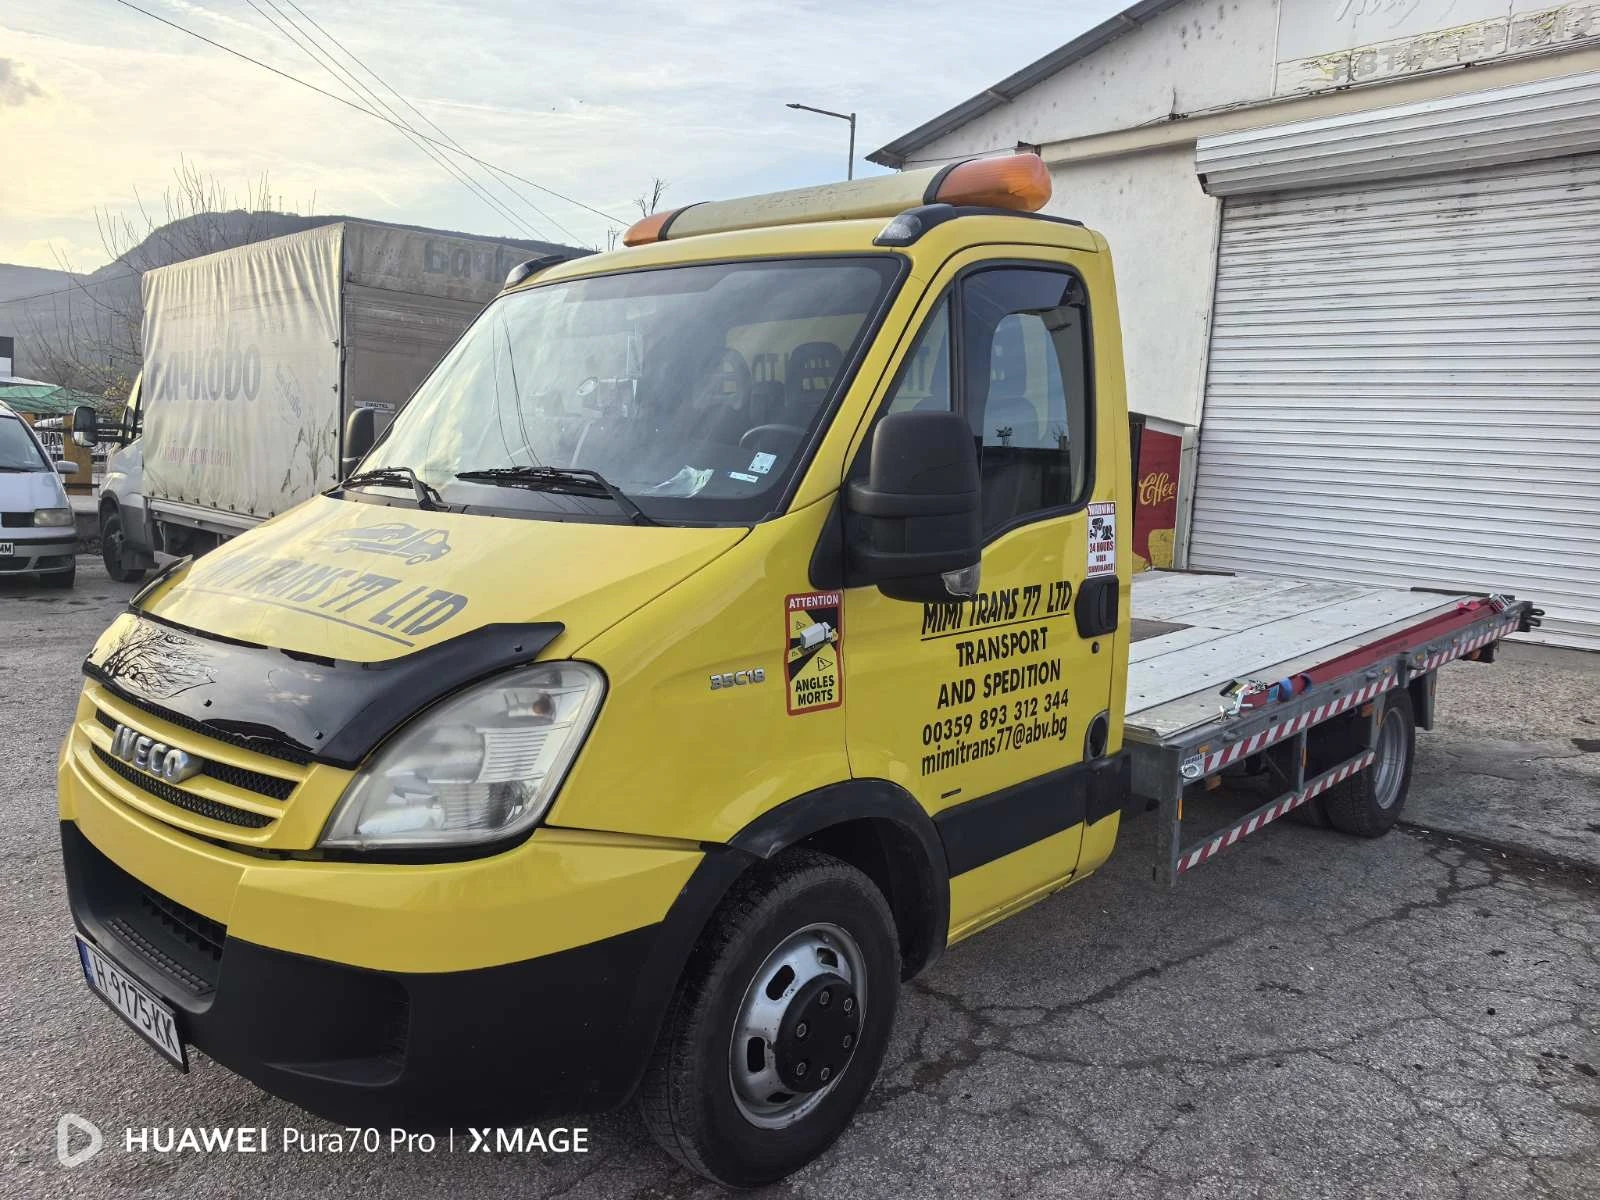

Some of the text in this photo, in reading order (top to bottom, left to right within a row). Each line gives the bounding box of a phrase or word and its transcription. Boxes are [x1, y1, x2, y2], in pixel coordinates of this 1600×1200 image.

[318, 572, 402, 613] 77
[368, 585, 469, 636] LTD
[789, 594, 839, 609] ATTENTION
[922, 581, 1073, 635] MIMI TRANS 77 LTD
[956, 627, 1048, 668] TRANSPORT
[795, 675, 835, 692] ANGLES
[797, 688, 833, 706] MORTS
[937, 658, 1061, 710] AND SPEDITION
[922, 688, 1069, 746] 00359 893 312 344
[110, 724, 189, 784] IVECO
[922, 712, 1068, 777] mimitrans77@abv.bg
